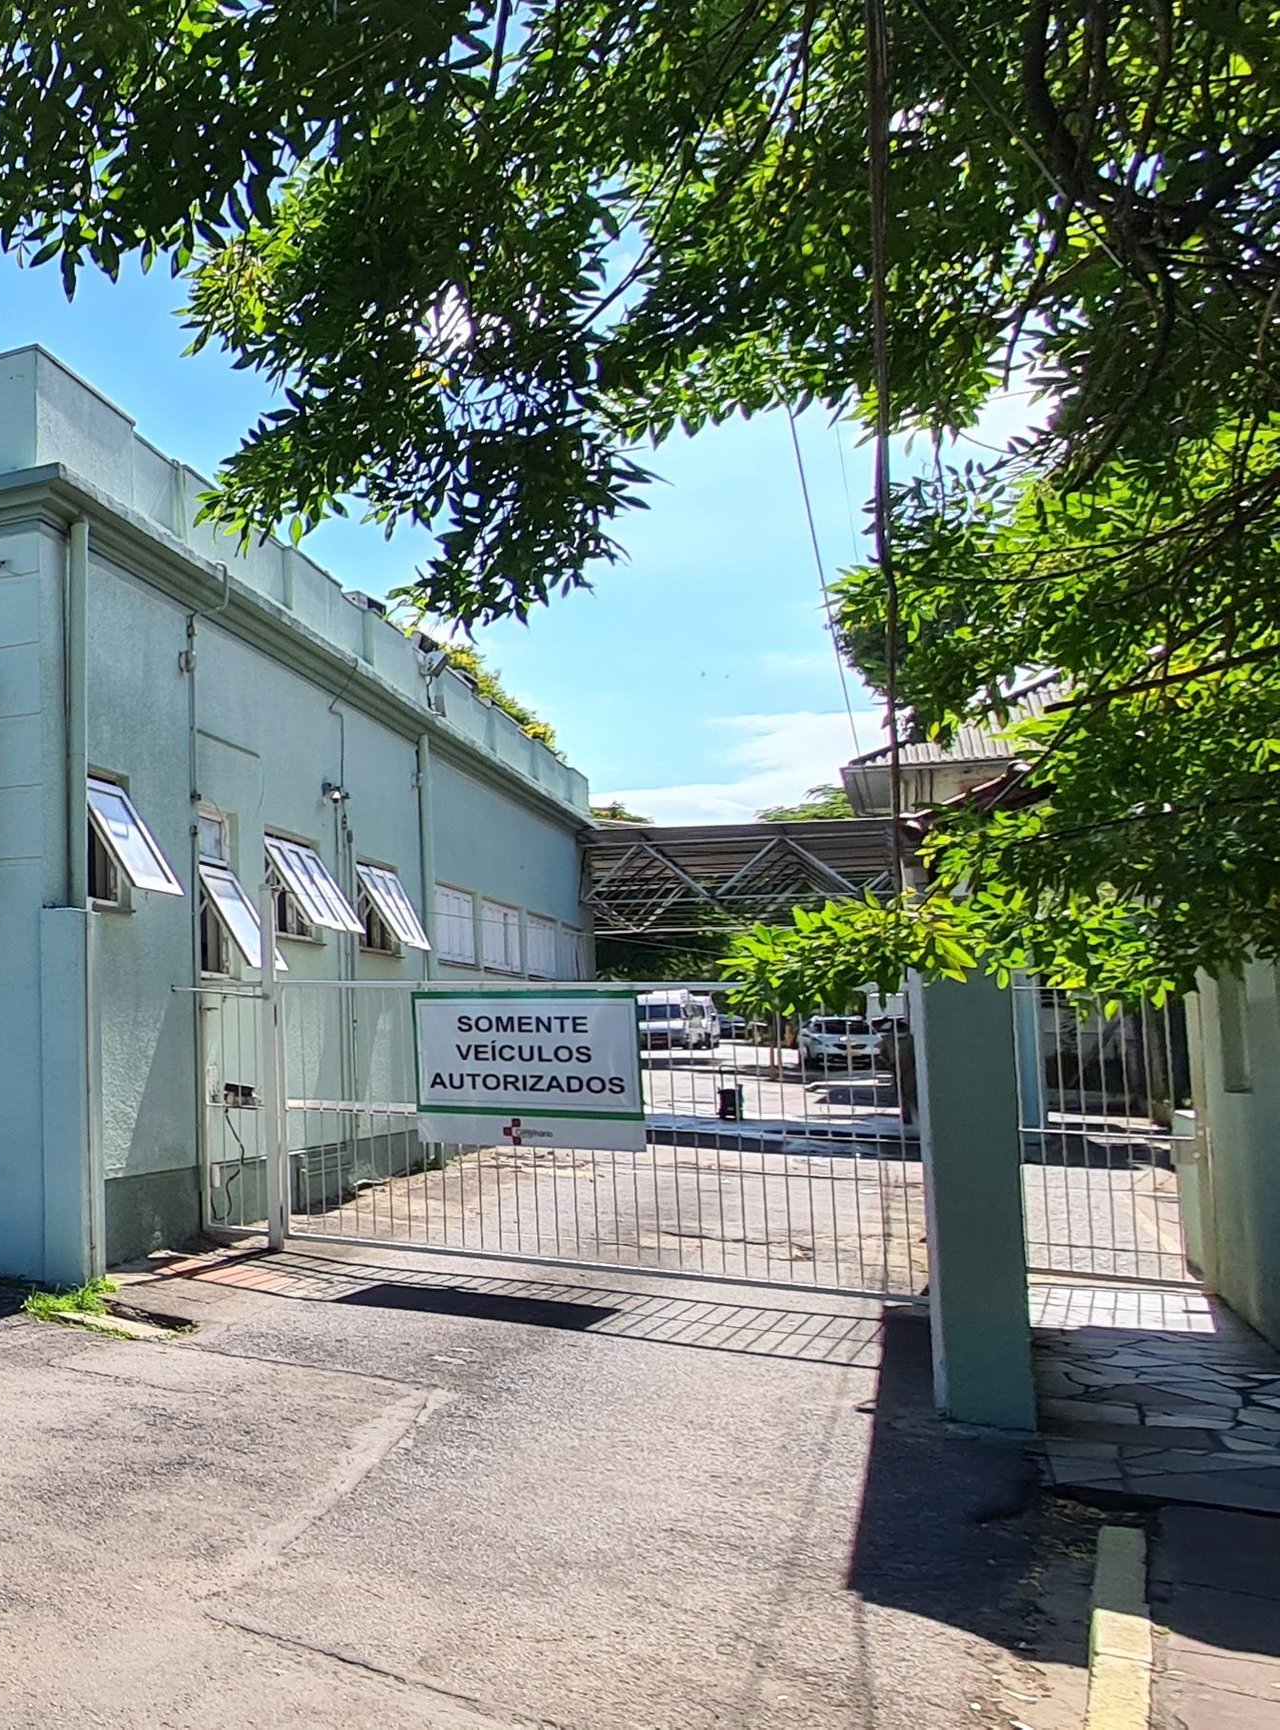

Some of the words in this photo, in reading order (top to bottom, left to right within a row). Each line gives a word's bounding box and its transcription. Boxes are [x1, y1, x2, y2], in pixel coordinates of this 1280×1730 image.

[457, 1015, 588, 1033] SOMENTE
[456, 1041, 592, 1063] VEÍCULOS
[430, 1072, 625, 1094] AUTORIZADOS
